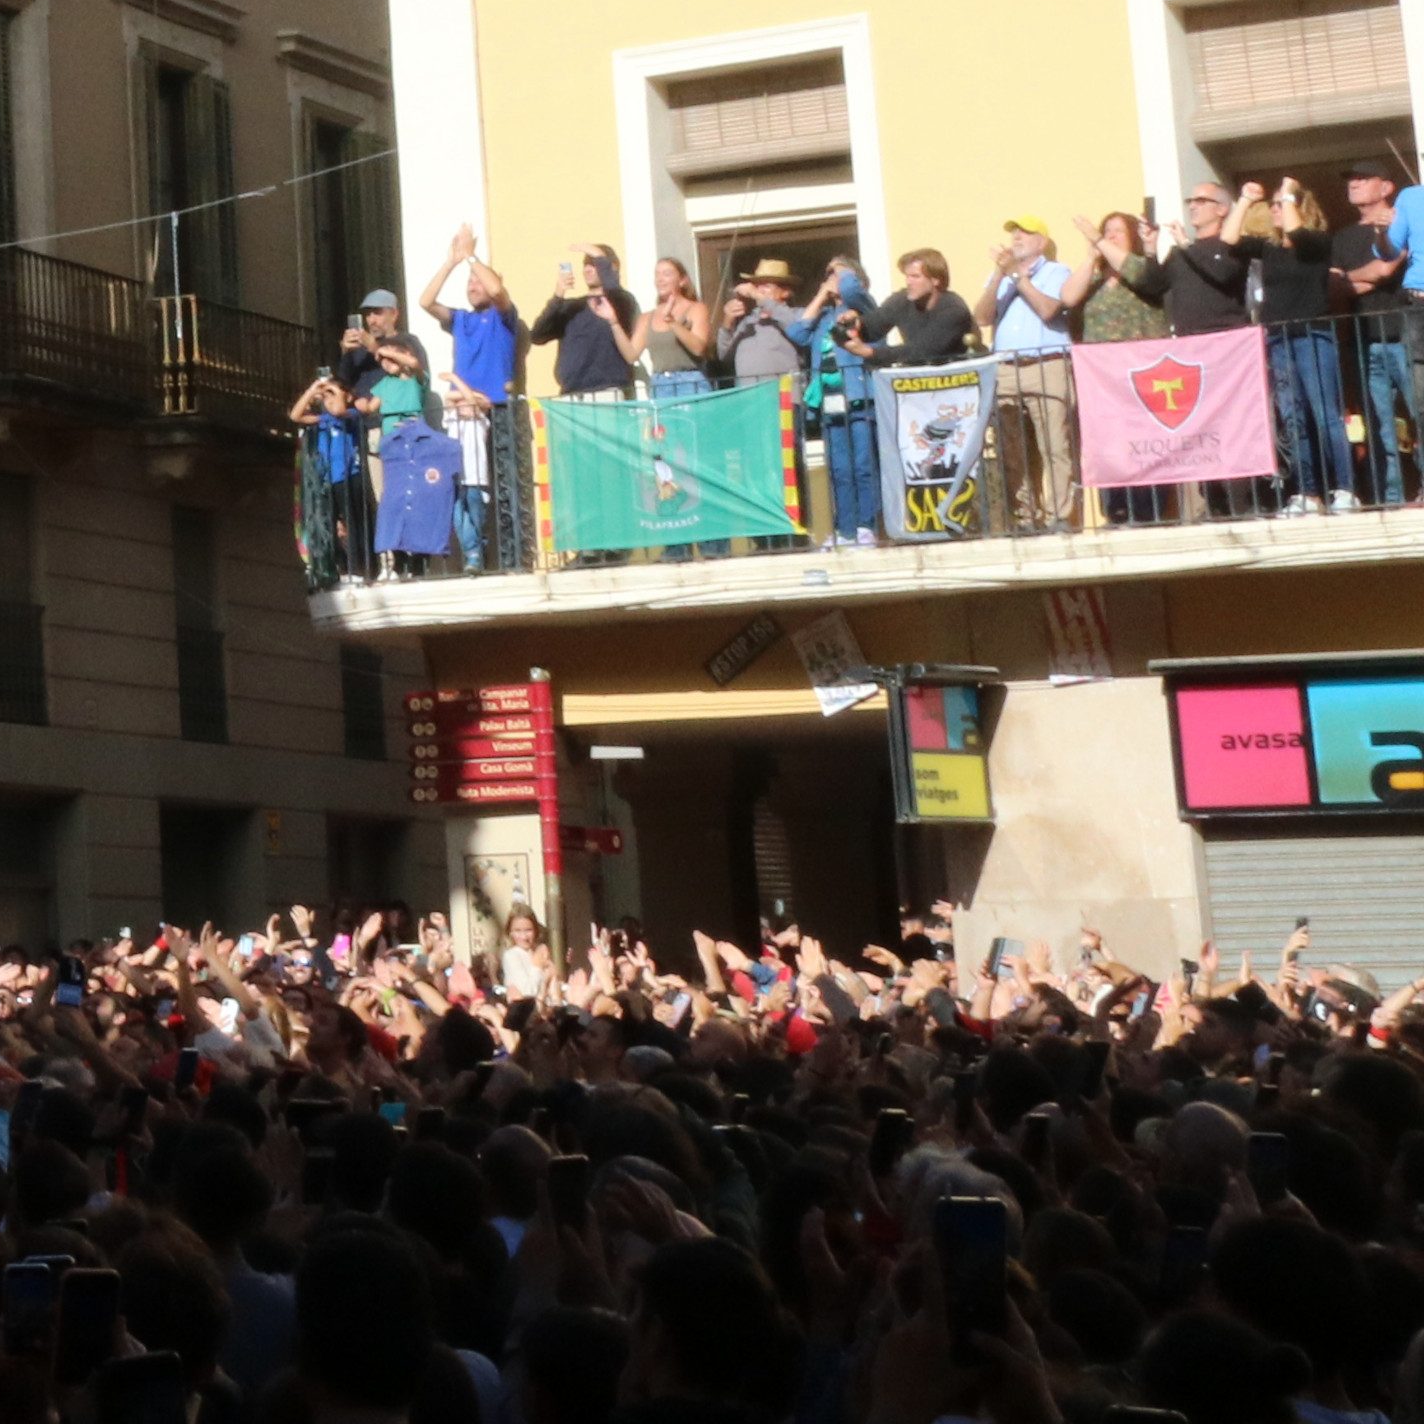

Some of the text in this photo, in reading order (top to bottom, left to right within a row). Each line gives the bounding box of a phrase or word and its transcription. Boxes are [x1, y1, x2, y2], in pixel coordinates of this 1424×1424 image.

[892, 373, 978, 392] CASTELLERS
[1129, 432, 1221, 457] XIQUETS
[479, 688, 527, 700] Campanar
[479, 720, 505, 732] Palau
[492, 741, 533, 752] Vinseum
[1220, 732, 1304, 750] avasa
[480, 763, 502, 774] Casa
[480, 785, 534, 797] Modernista
